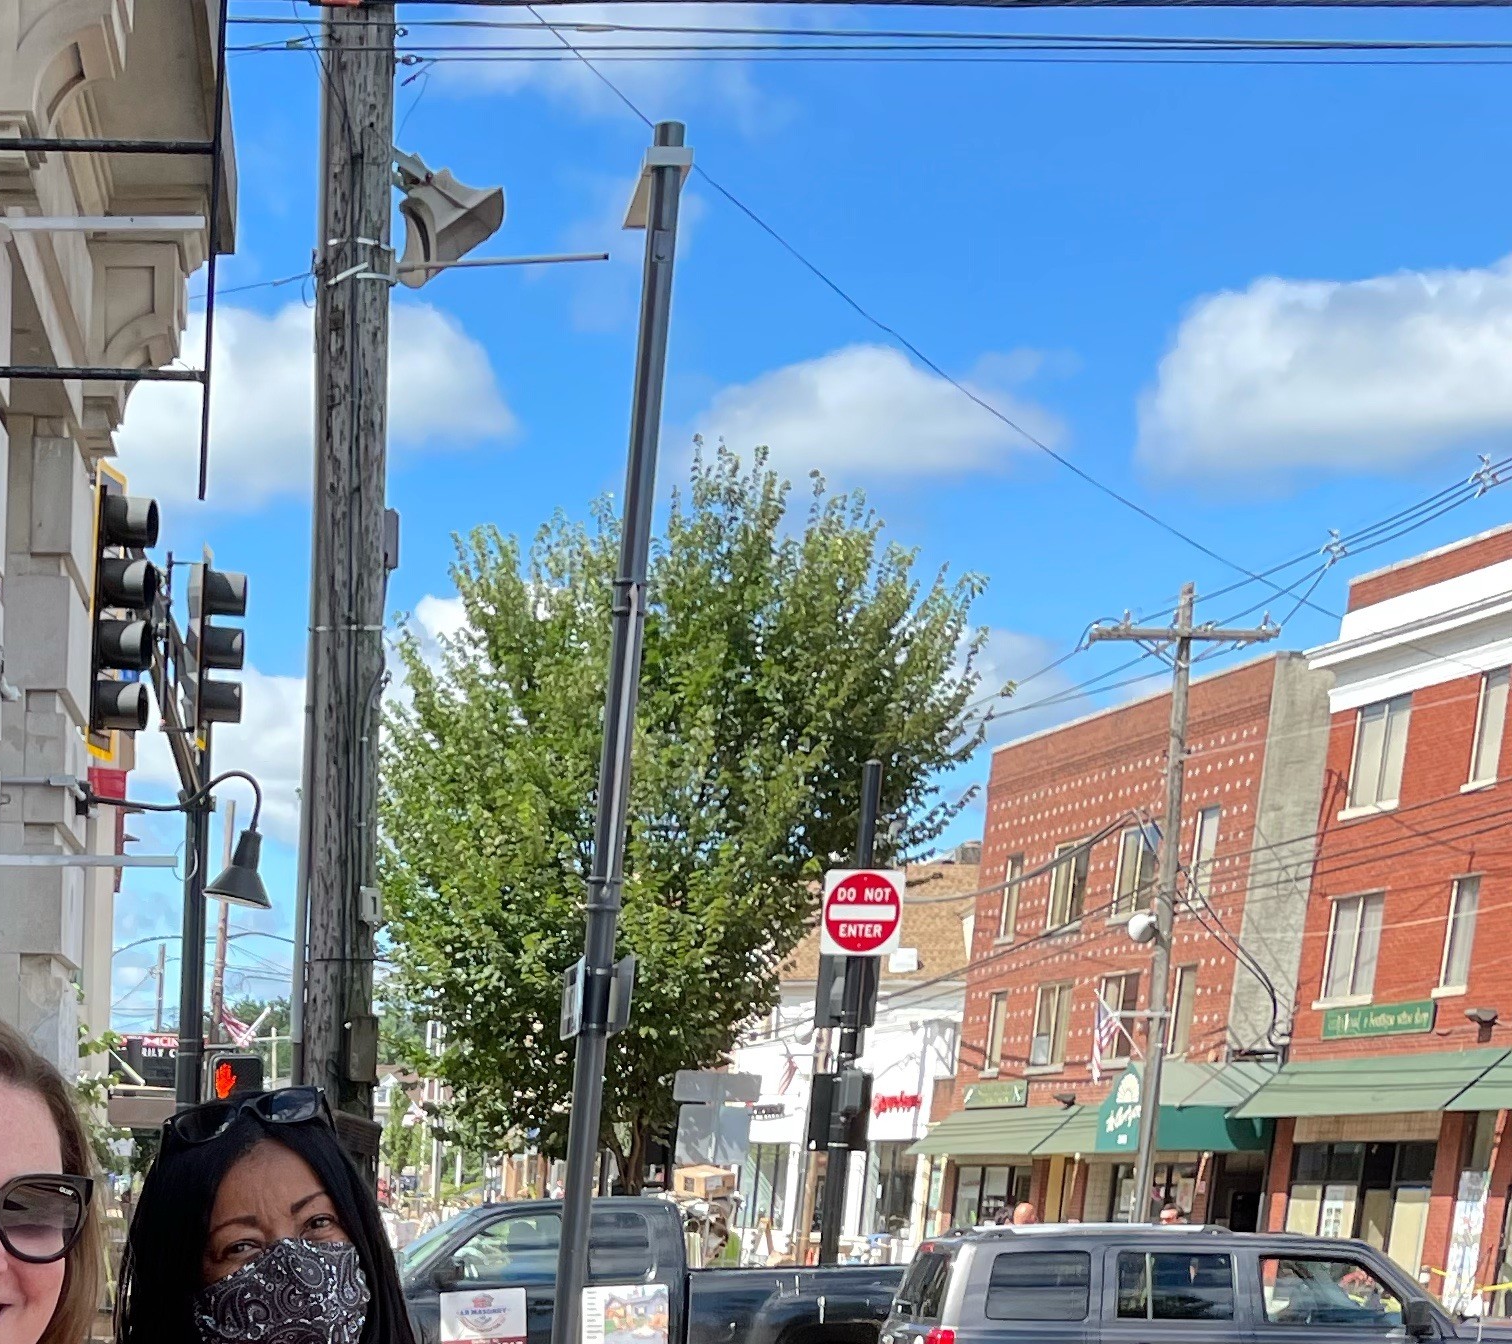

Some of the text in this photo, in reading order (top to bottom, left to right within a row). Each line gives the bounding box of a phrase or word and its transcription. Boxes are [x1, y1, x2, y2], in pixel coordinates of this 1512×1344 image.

[837, 887, 892, 903] DO NOT
[838, 923, 883, 938] ENTER
